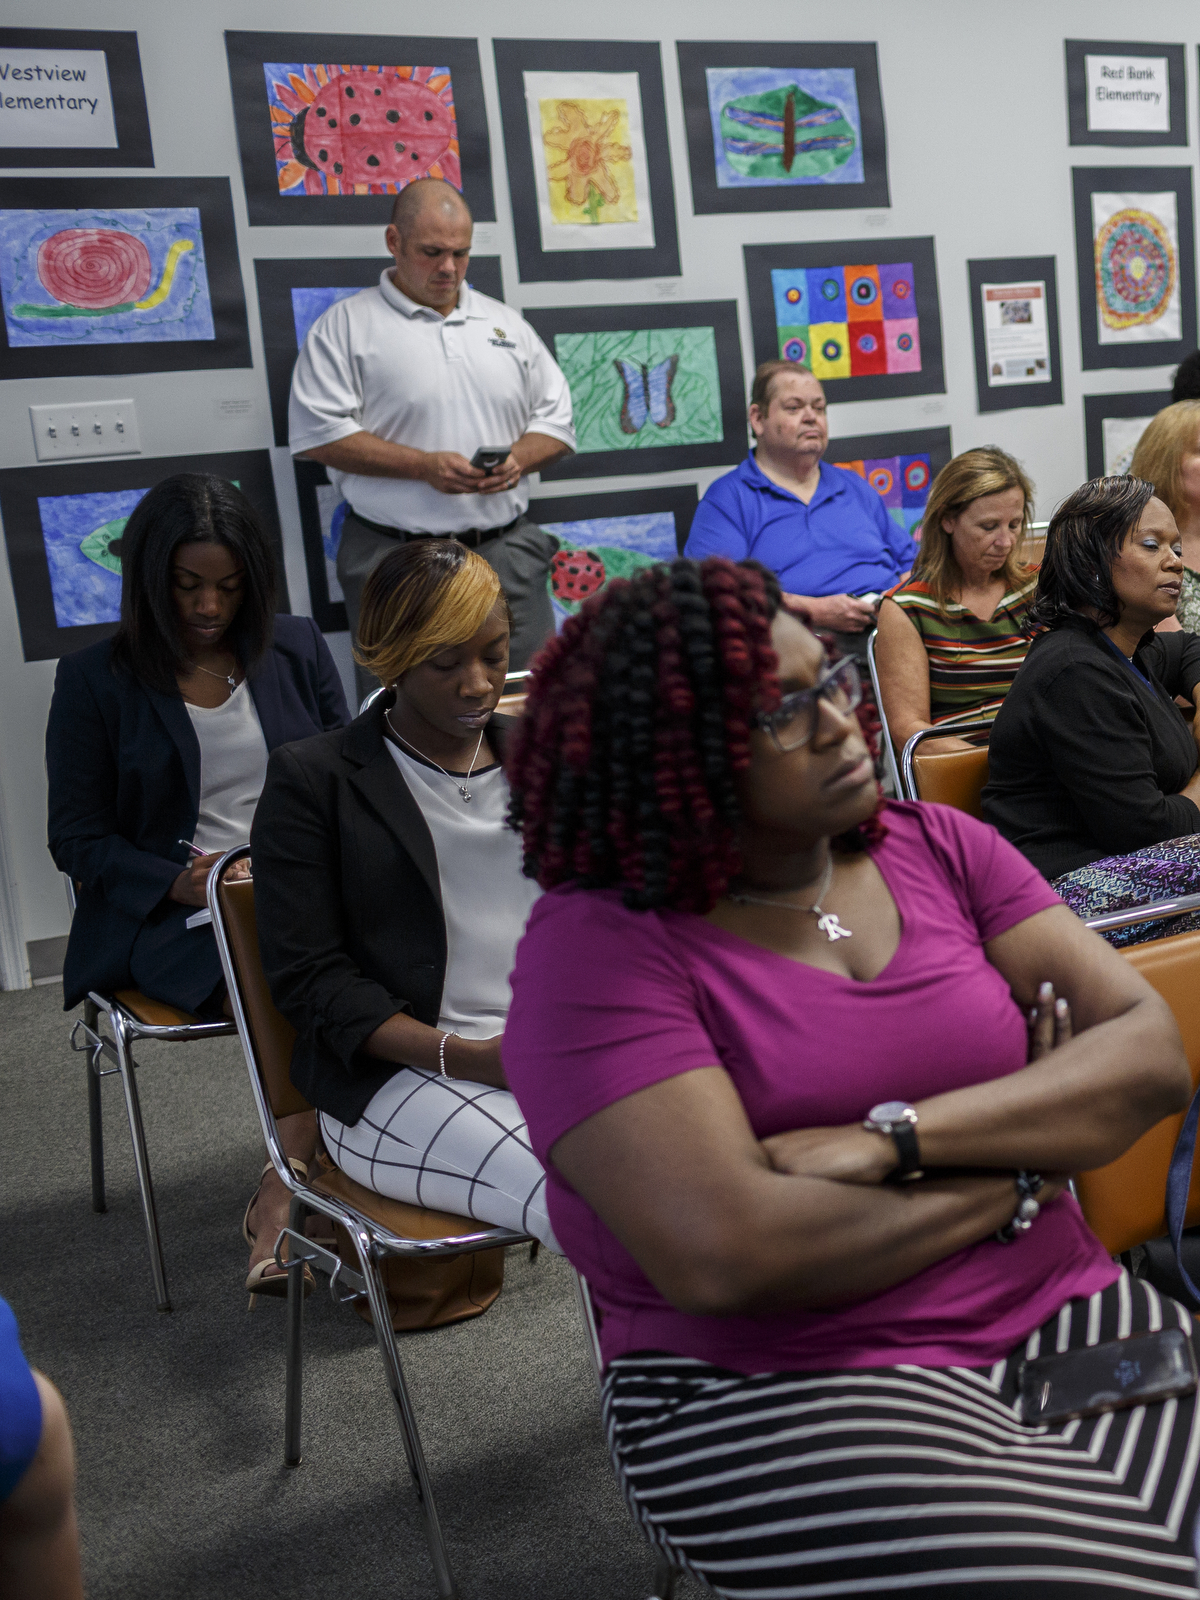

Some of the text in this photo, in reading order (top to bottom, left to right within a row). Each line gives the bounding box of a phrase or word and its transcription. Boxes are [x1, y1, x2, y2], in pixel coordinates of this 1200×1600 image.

[1101, 65, 1155, 80] Red Bank
[1096, 86, 1162, 106] Elementary
